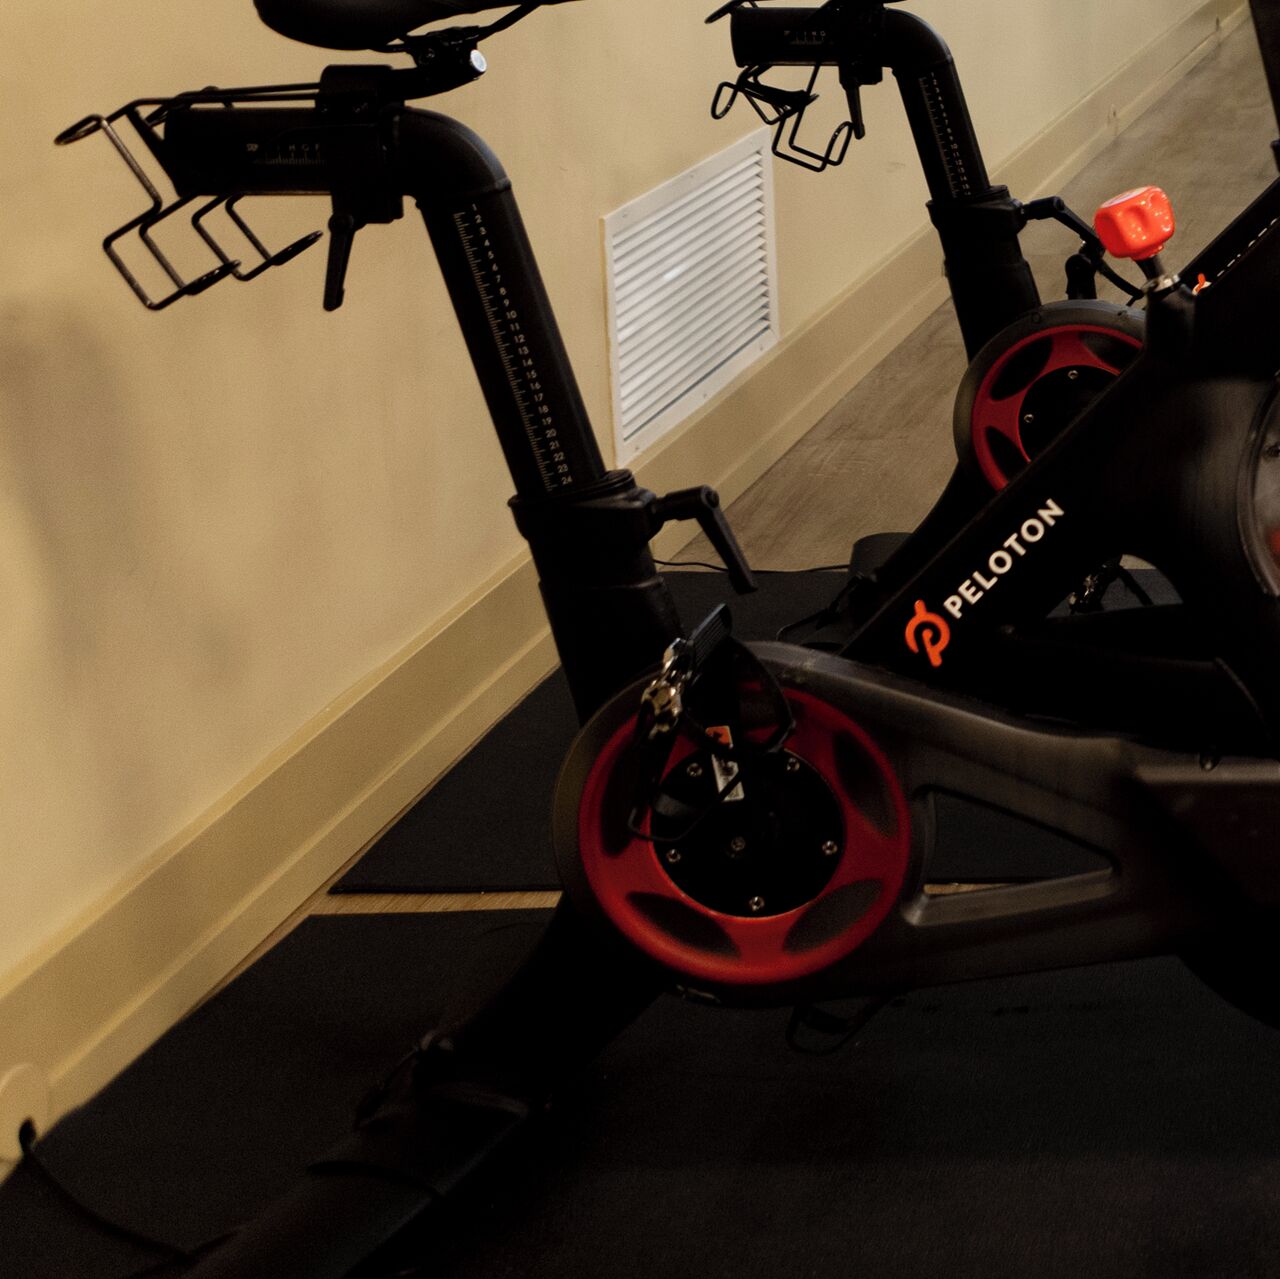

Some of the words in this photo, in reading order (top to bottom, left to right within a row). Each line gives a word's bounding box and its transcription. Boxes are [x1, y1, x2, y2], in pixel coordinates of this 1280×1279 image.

[506, 310, 517, 319] 10
[510, 322, 520, 331] 11
[514, 334, 525, 343] 12
[518, 346, 529, 355] 13
[522, 358, 533, 367] 14
[526, 370, 537, 379] 15
[530, 382, 541, 391] 16
[534, 393, 544, 402] 17
[538, 405, 549, 414] 18
[542, 417, 552, 426] 19
[545, 429, 557, 438] 20
[549, 441, 560, 450] 21
[553, 452, 565, 462] 22
[557, 464, 569, 473] 23
[561, 476, 573, 485] 24
[943, 498, 1065, 619] PELOTON
